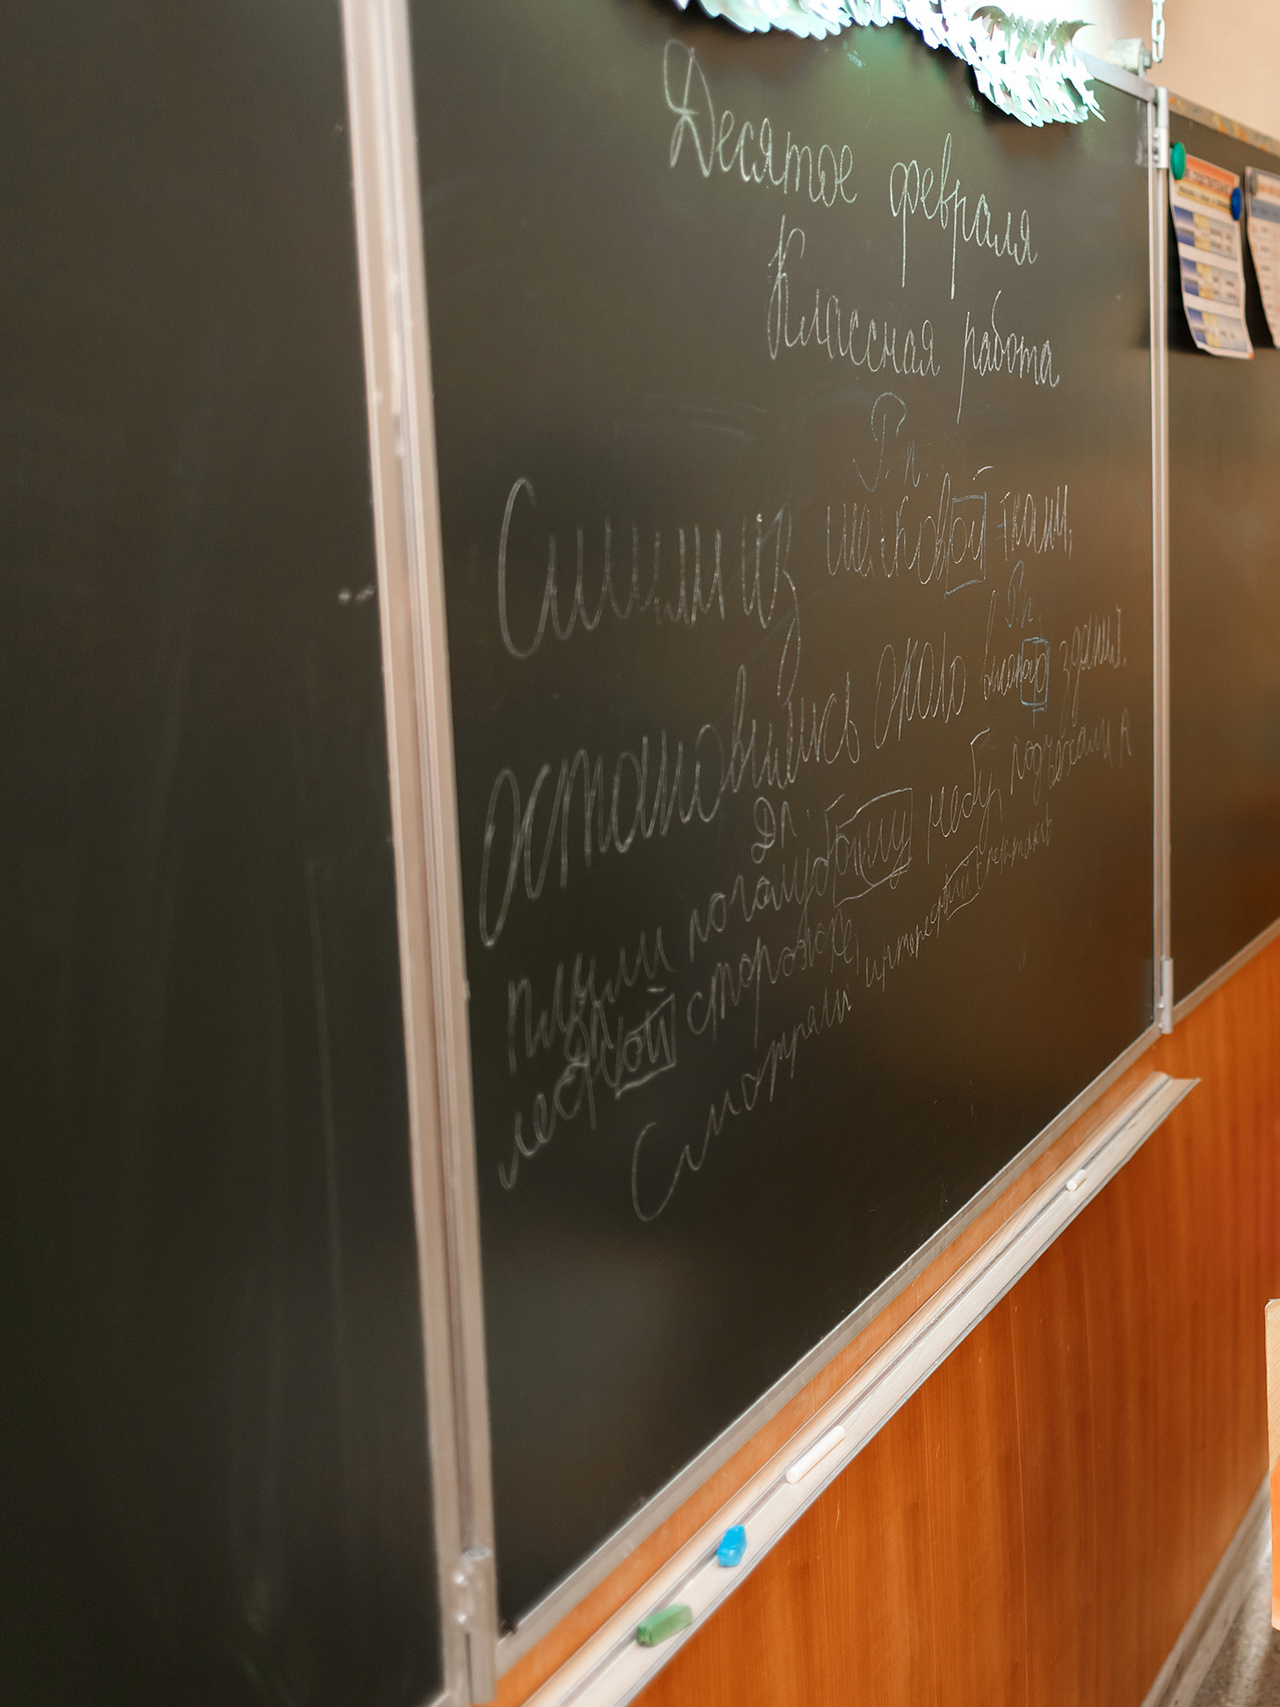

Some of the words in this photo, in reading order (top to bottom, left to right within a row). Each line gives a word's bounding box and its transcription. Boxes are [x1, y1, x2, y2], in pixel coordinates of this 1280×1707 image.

[664, 39, 858, 208] Десятое
[890, 132, 1038, 300] февраля
[767, 214, 941, 377] Классная
[955, 290, 1060, 423] работа
